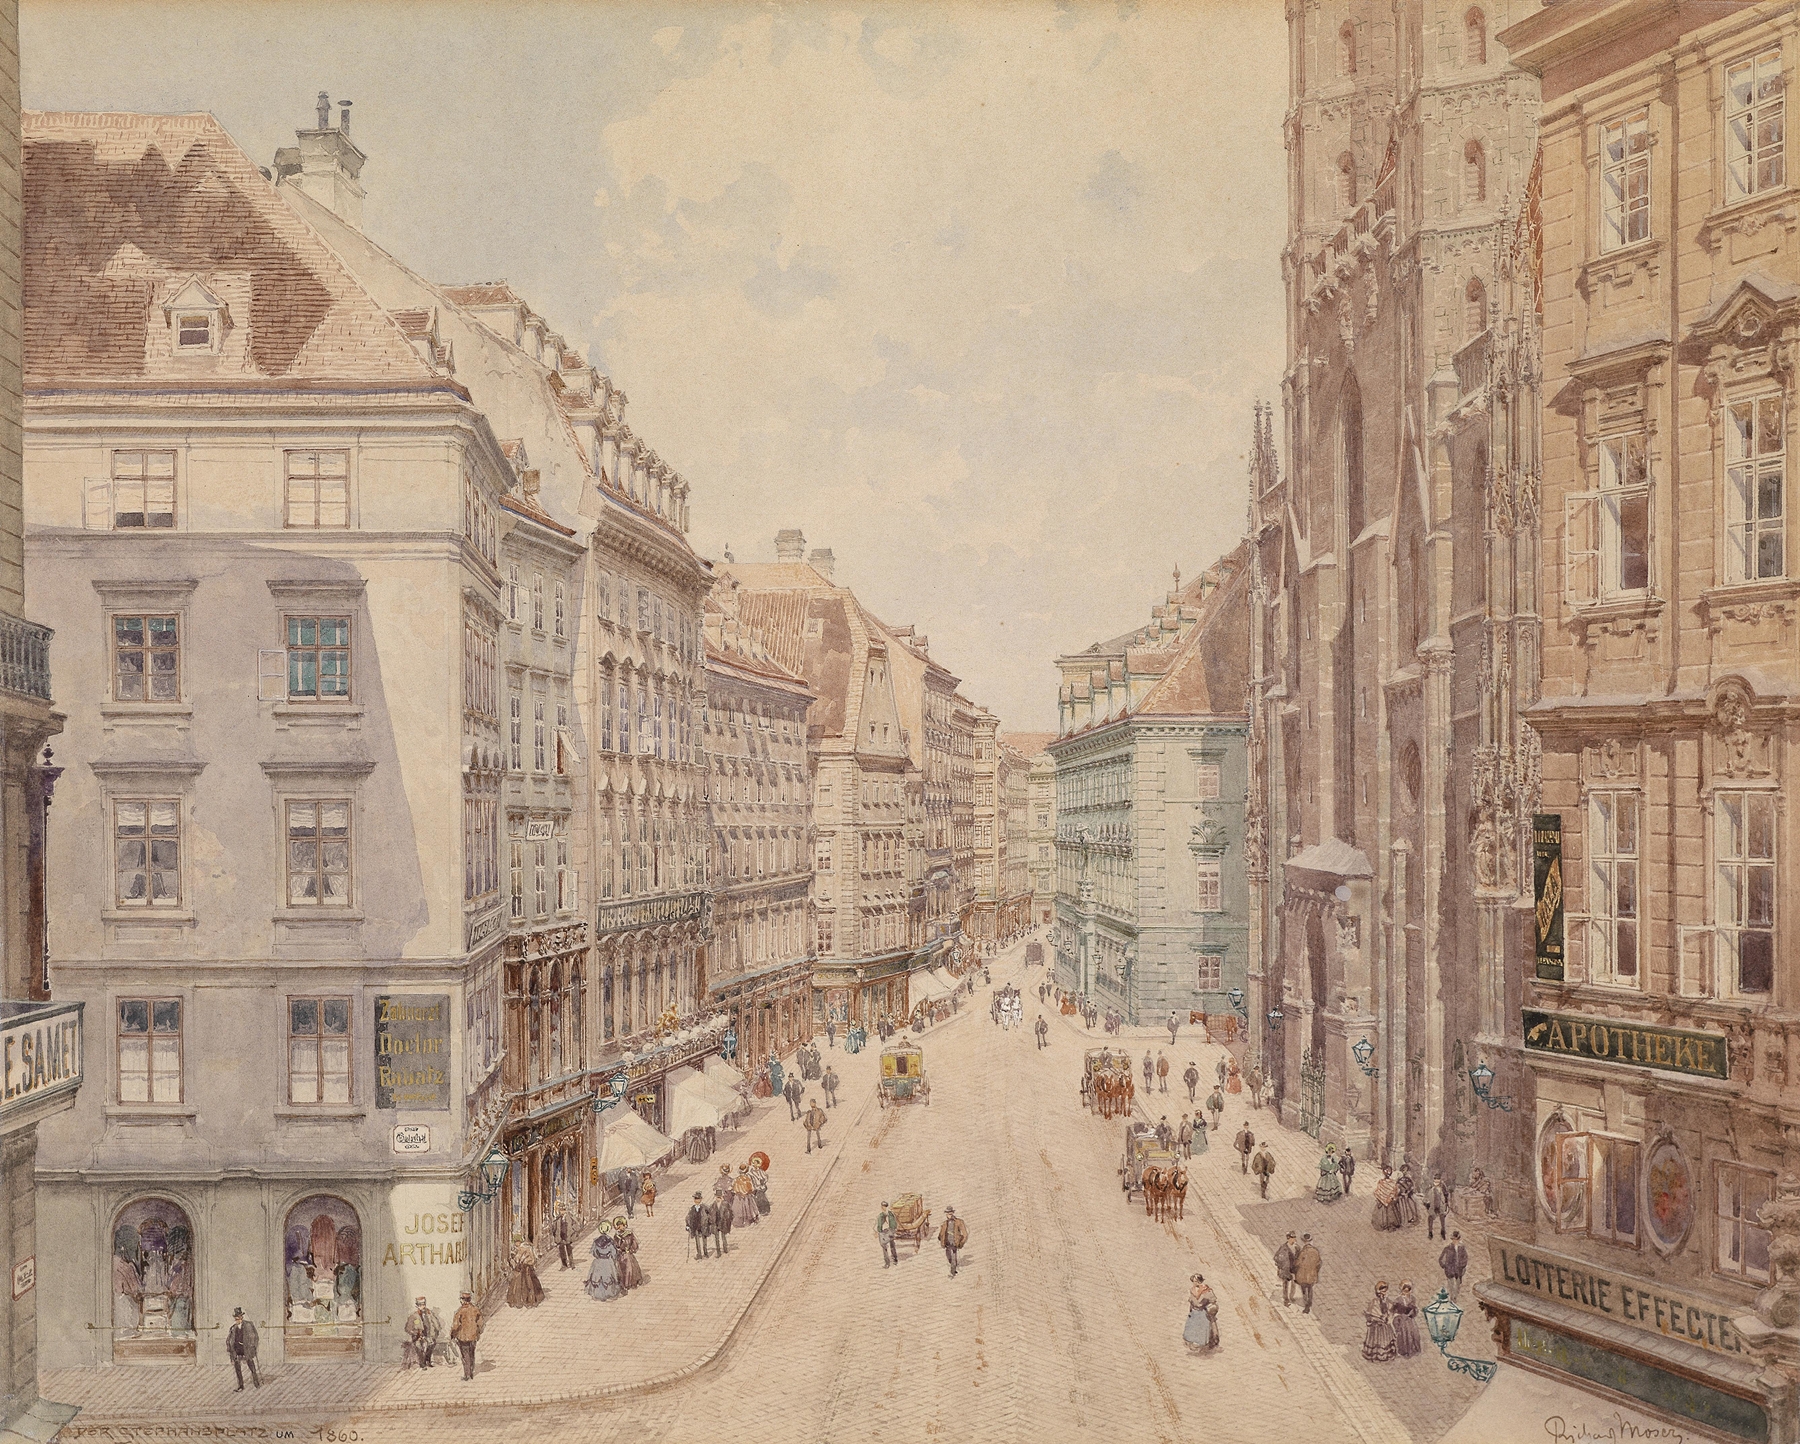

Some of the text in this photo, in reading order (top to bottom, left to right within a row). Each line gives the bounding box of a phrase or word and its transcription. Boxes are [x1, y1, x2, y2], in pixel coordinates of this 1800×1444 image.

[1547, 1019, 1717, 1073] APOTHEKE
[404, 1212, 465, 1235] JOSEF
[1501, 1248, 1612, 1314] LOTTERIE
